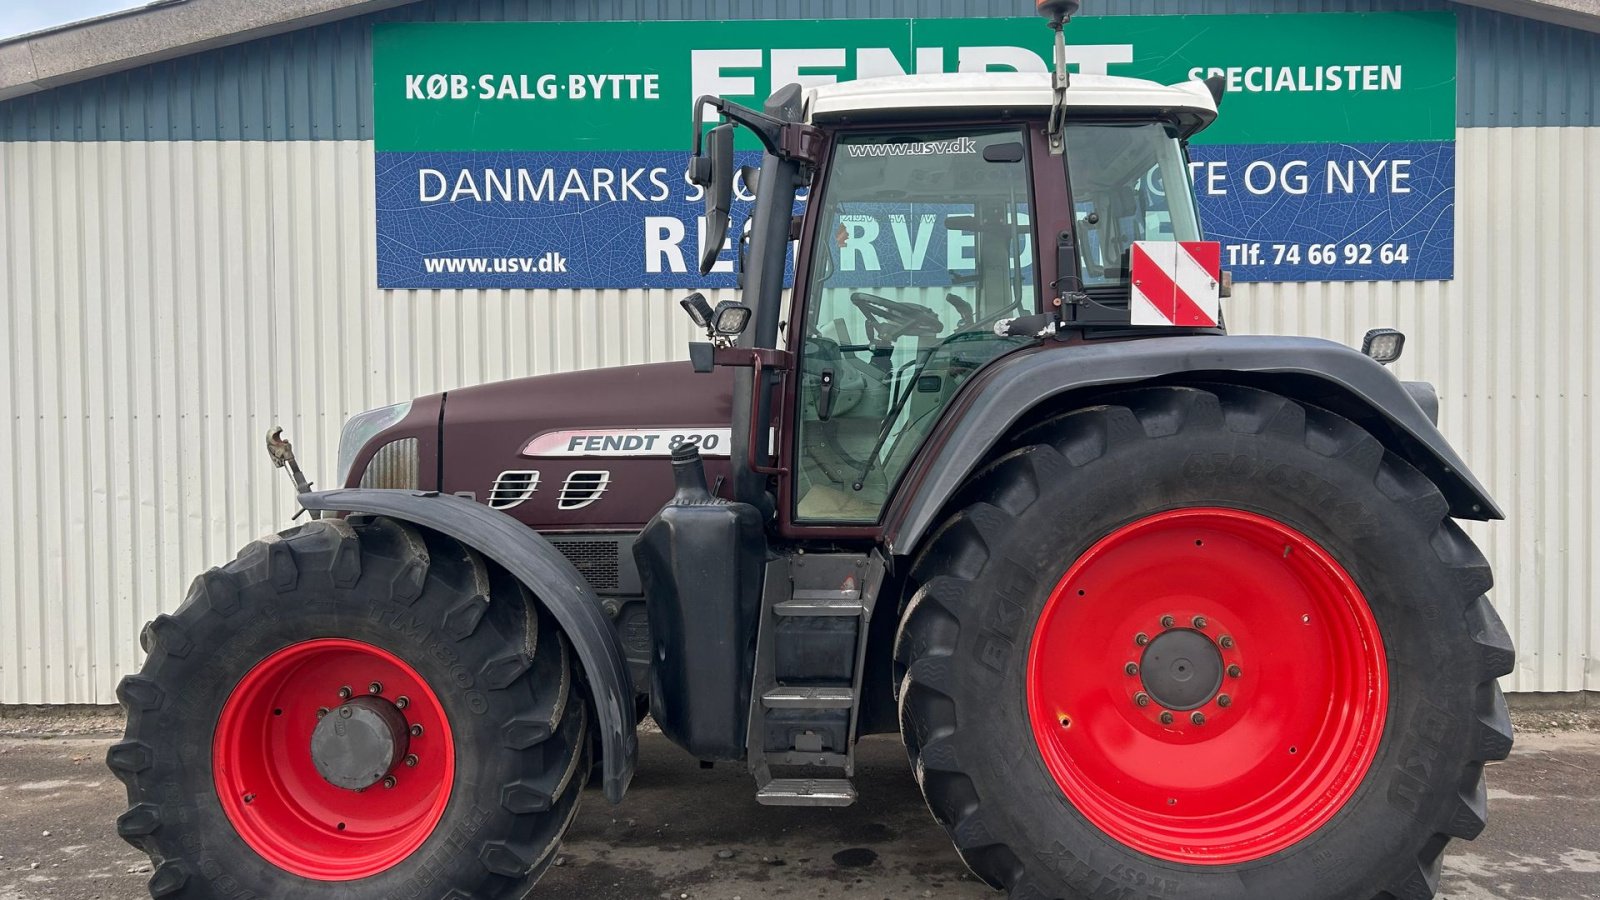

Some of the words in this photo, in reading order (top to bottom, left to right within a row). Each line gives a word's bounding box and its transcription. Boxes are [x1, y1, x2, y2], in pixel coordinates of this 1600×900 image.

[847, 137, 977, 157] www.usv.dk
[419, 168, 669, 202] DANMARKS
[1244, 160, 1308, 195] OG
[1327, 160, 1411, 194] NYE
[424, 252, 567, 273] www.usv.dk
[1226, 244, 1266, 266] Tlf.
[1272, 244, 1301, 265] 74
[1307, 244, 1337, 265] 66
[1343, 243, 1373, 264] 92
[1378, 243, 1409, 264] 64
[567, 435, 660, 451] FENDT
[668, 434, 719, 450] 820
